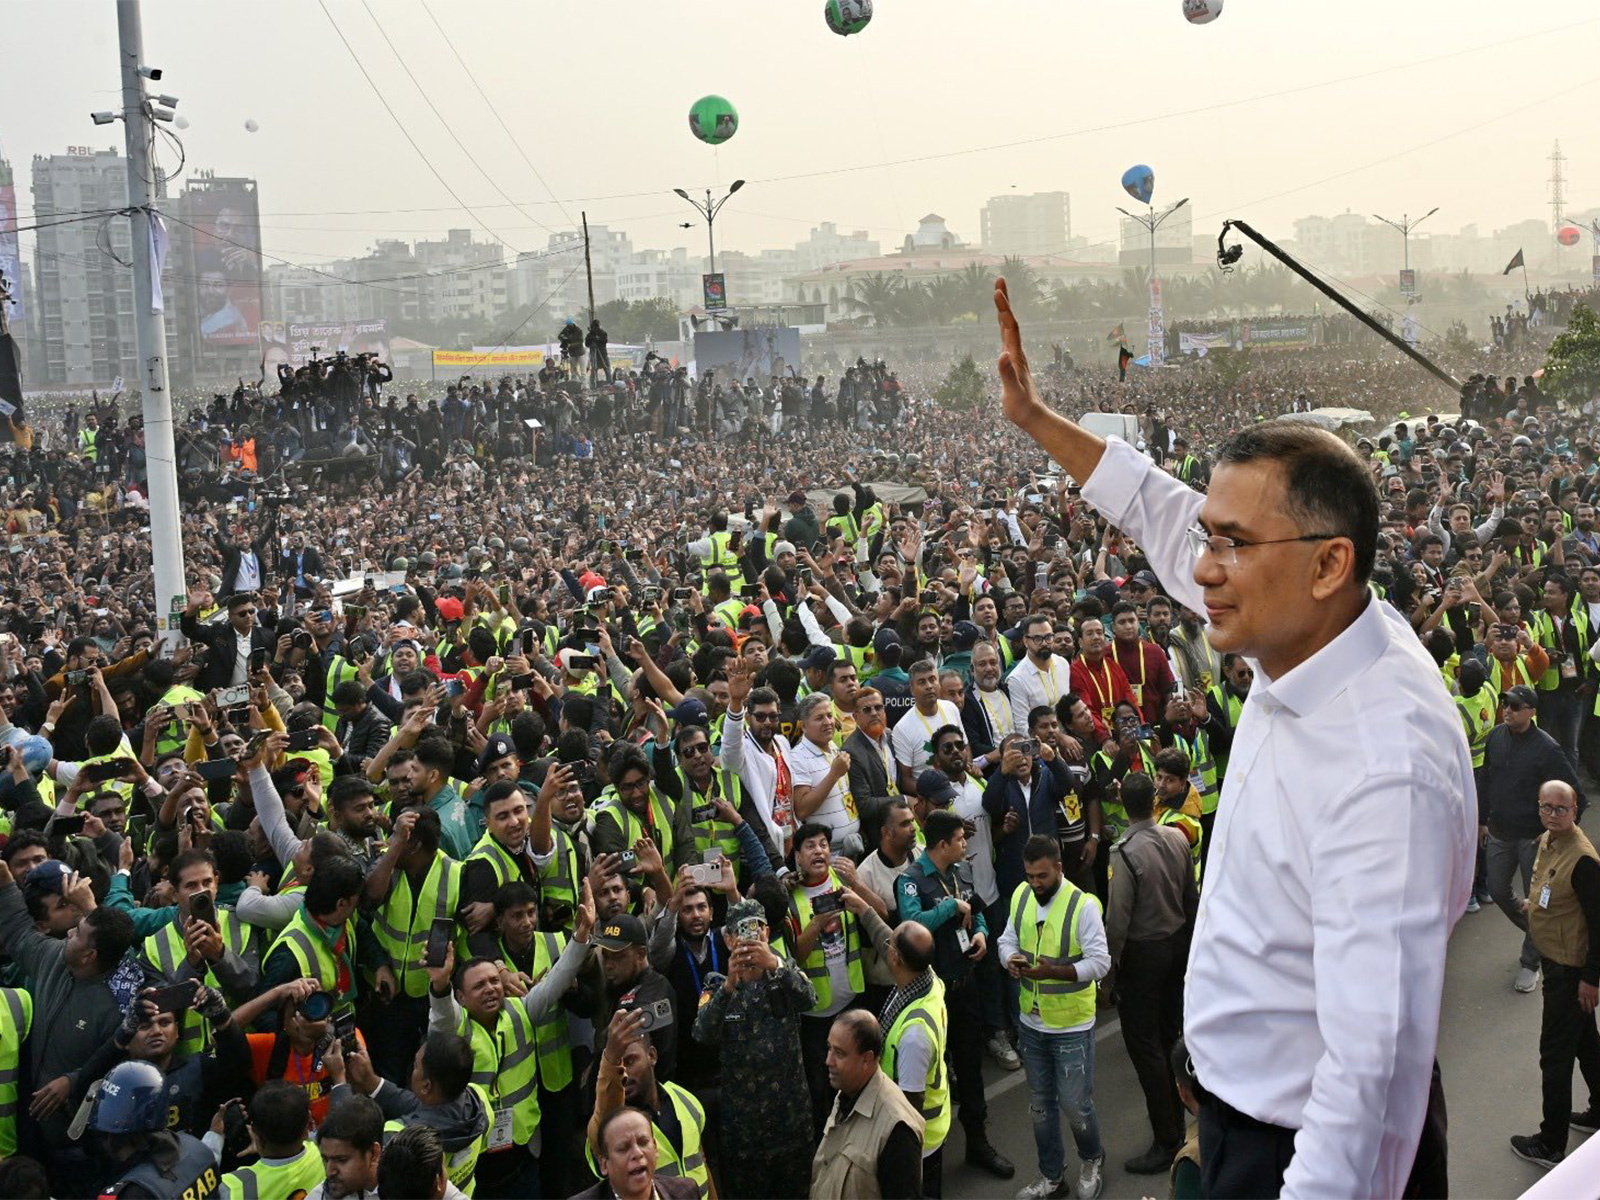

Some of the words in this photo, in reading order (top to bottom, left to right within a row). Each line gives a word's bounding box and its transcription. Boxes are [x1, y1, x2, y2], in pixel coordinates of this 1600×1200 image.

[67, 146, 94, 156] RBL
[885, 697, 916, 707] POLICE
[182, 1167, 217, 1200] RAB
